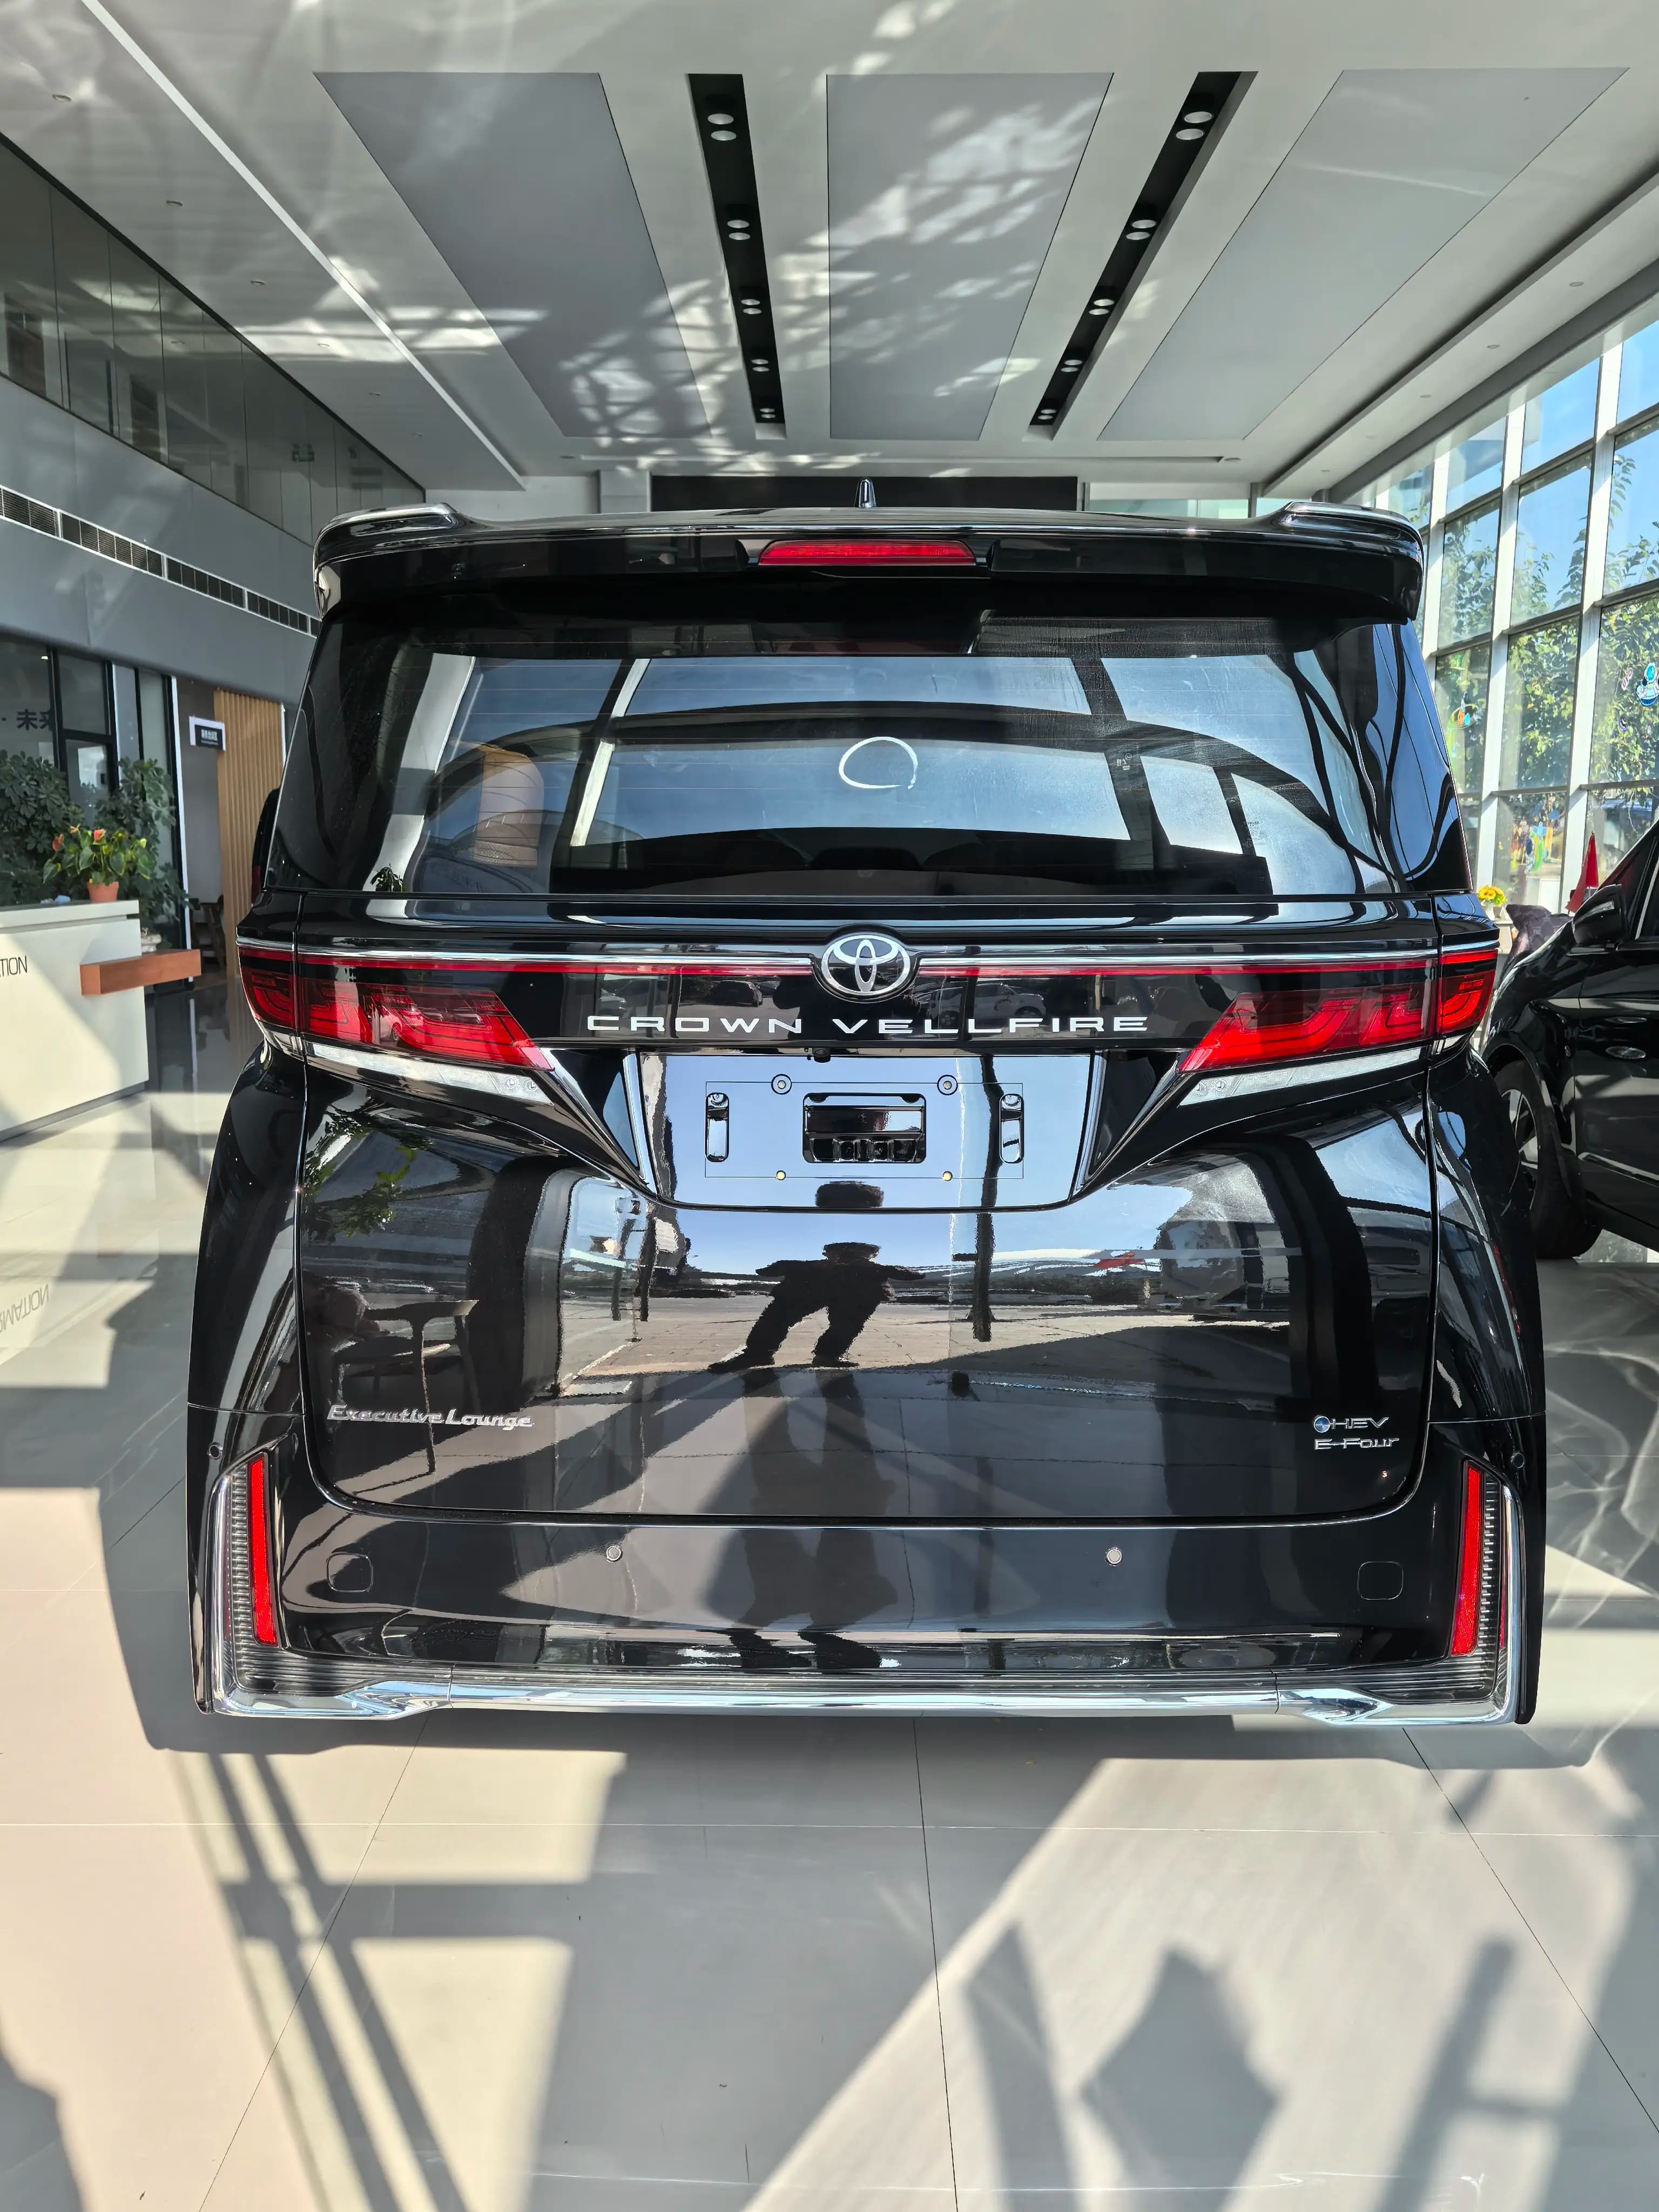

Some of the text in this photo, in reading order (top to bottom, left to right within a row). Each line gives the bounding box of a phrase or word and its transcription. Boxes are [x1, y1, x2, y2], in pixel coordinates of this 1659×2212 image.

[0, 955, 28, 976] TION
[587, 1016, 1148, 1034] CROWN VELLFIRE
[327, 1404, 534, 1431] Executive Lounge
[1331, 1417, 1390, 1429] HEV
[1314, 1438, 1400, 1450] E-Four
